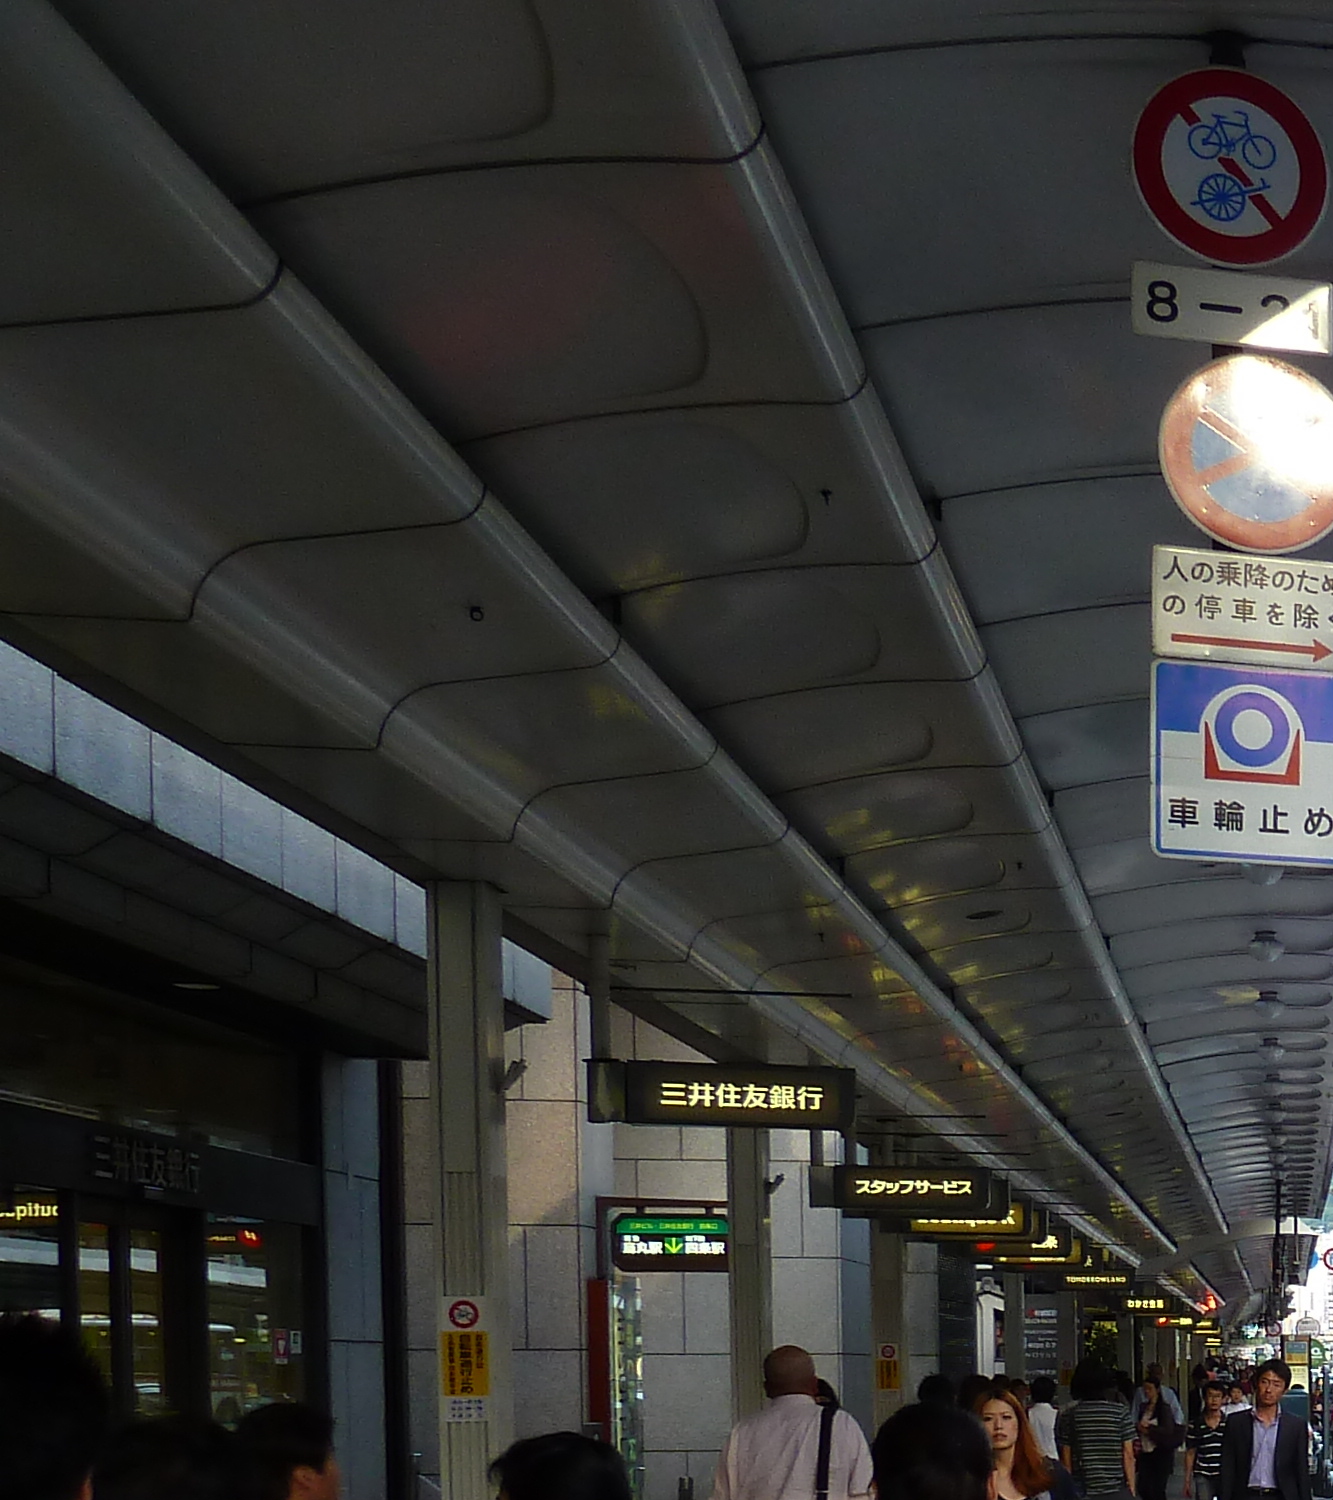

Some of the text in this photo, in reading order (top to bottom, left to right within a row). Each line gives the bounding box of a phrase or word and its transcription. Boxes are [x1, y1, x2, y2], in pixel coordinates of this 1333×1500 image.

[1168, 797, 1333, 837] 車輪止め
[660, 1082, 824, 1111] 三井住友銀行
[855, 1178, 973, 1196] スタッフサービス
